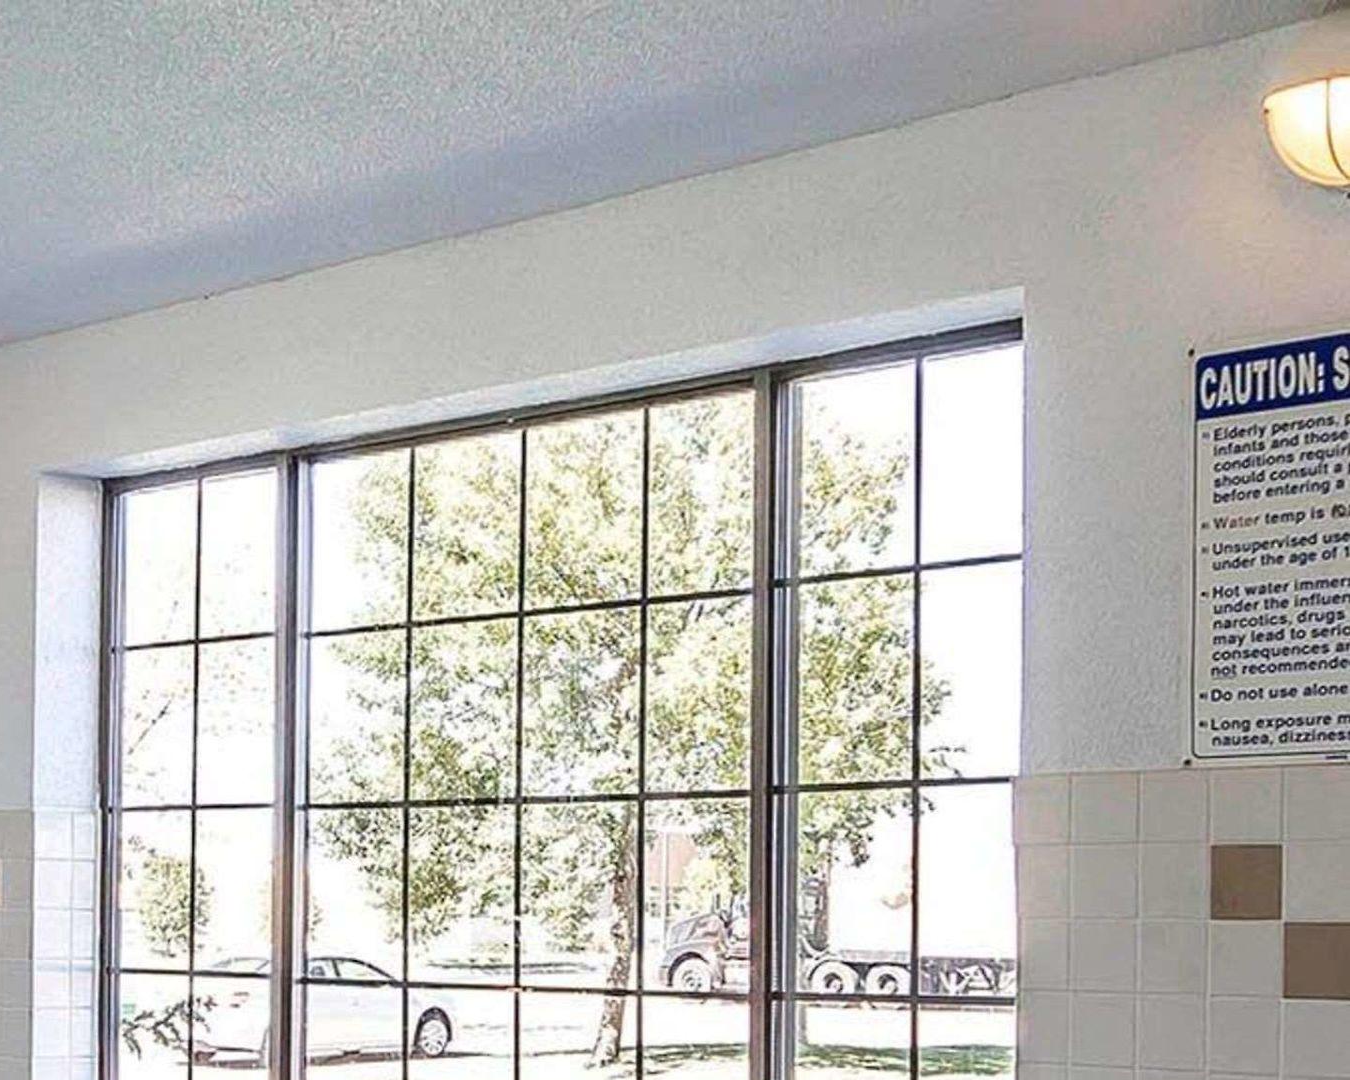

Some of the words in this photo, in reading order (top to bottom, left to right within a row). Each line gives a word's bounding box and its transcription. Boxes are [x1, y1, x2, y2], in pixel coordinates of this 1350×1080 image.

[1201, 352, 1325, 410] CAUTION:
[1213, 423, 1267, 442] Elderly
[1213, 441, 1266, 457] infants
[1271, 435, 1299, 450] and
[1304, 429, 1349, 445] those
[1213, 452, 1295, 473] conditions
[1213, 470, 1266, 489] should
[1269, 463, 1329, 482] consult
[1334, 462, 1343, 474] a
[1213, 488, 1261, 504] before
[1265, 480, 1330, 498] entering
[1335, 478, 1345, 490] a
[1213, 514, 1260, 530] Water
[1264, 510, 1306, 526] temp
[1310, 507, 1326, 520] is
[1212, 533, 1318, 556] Unsupervised
[1322, 531, 1350, 545] use
[1212, 556, 1256, 571] under
[1260, 553, 1284, 566] the
[1288, 550, 1317, 566] age
[1321, 547, 1338, 561] of
[1212, 585, 1240, 599] Hot
[1244, 582, 1290, 596] water
[1213, 599, 1260, 615] under
[1263, 597, 1290, 611] the
[1213, 614, 1293, 630] narcotics,
[1297, 610, 1345, 625] drugs
[1213, 632, 1246, 647] may
[1250, 628, 1285, 643] lead
[1290, 627, 1307, 640] to
[1212, 643, 1331, 662] consequences
[1211, 664, 1237, 678] not
[1210, 688, 1233, 702] Do
[1237, 687, 1264, 700] not
[1268, 685, 1298, 699] use
[1302, 682, 1349, 697] alone
[1210, 717, 1251, 733] Long
[1255, 714, 1332, 730] exposure
[1211, 733, 1274, 747] nausea,
